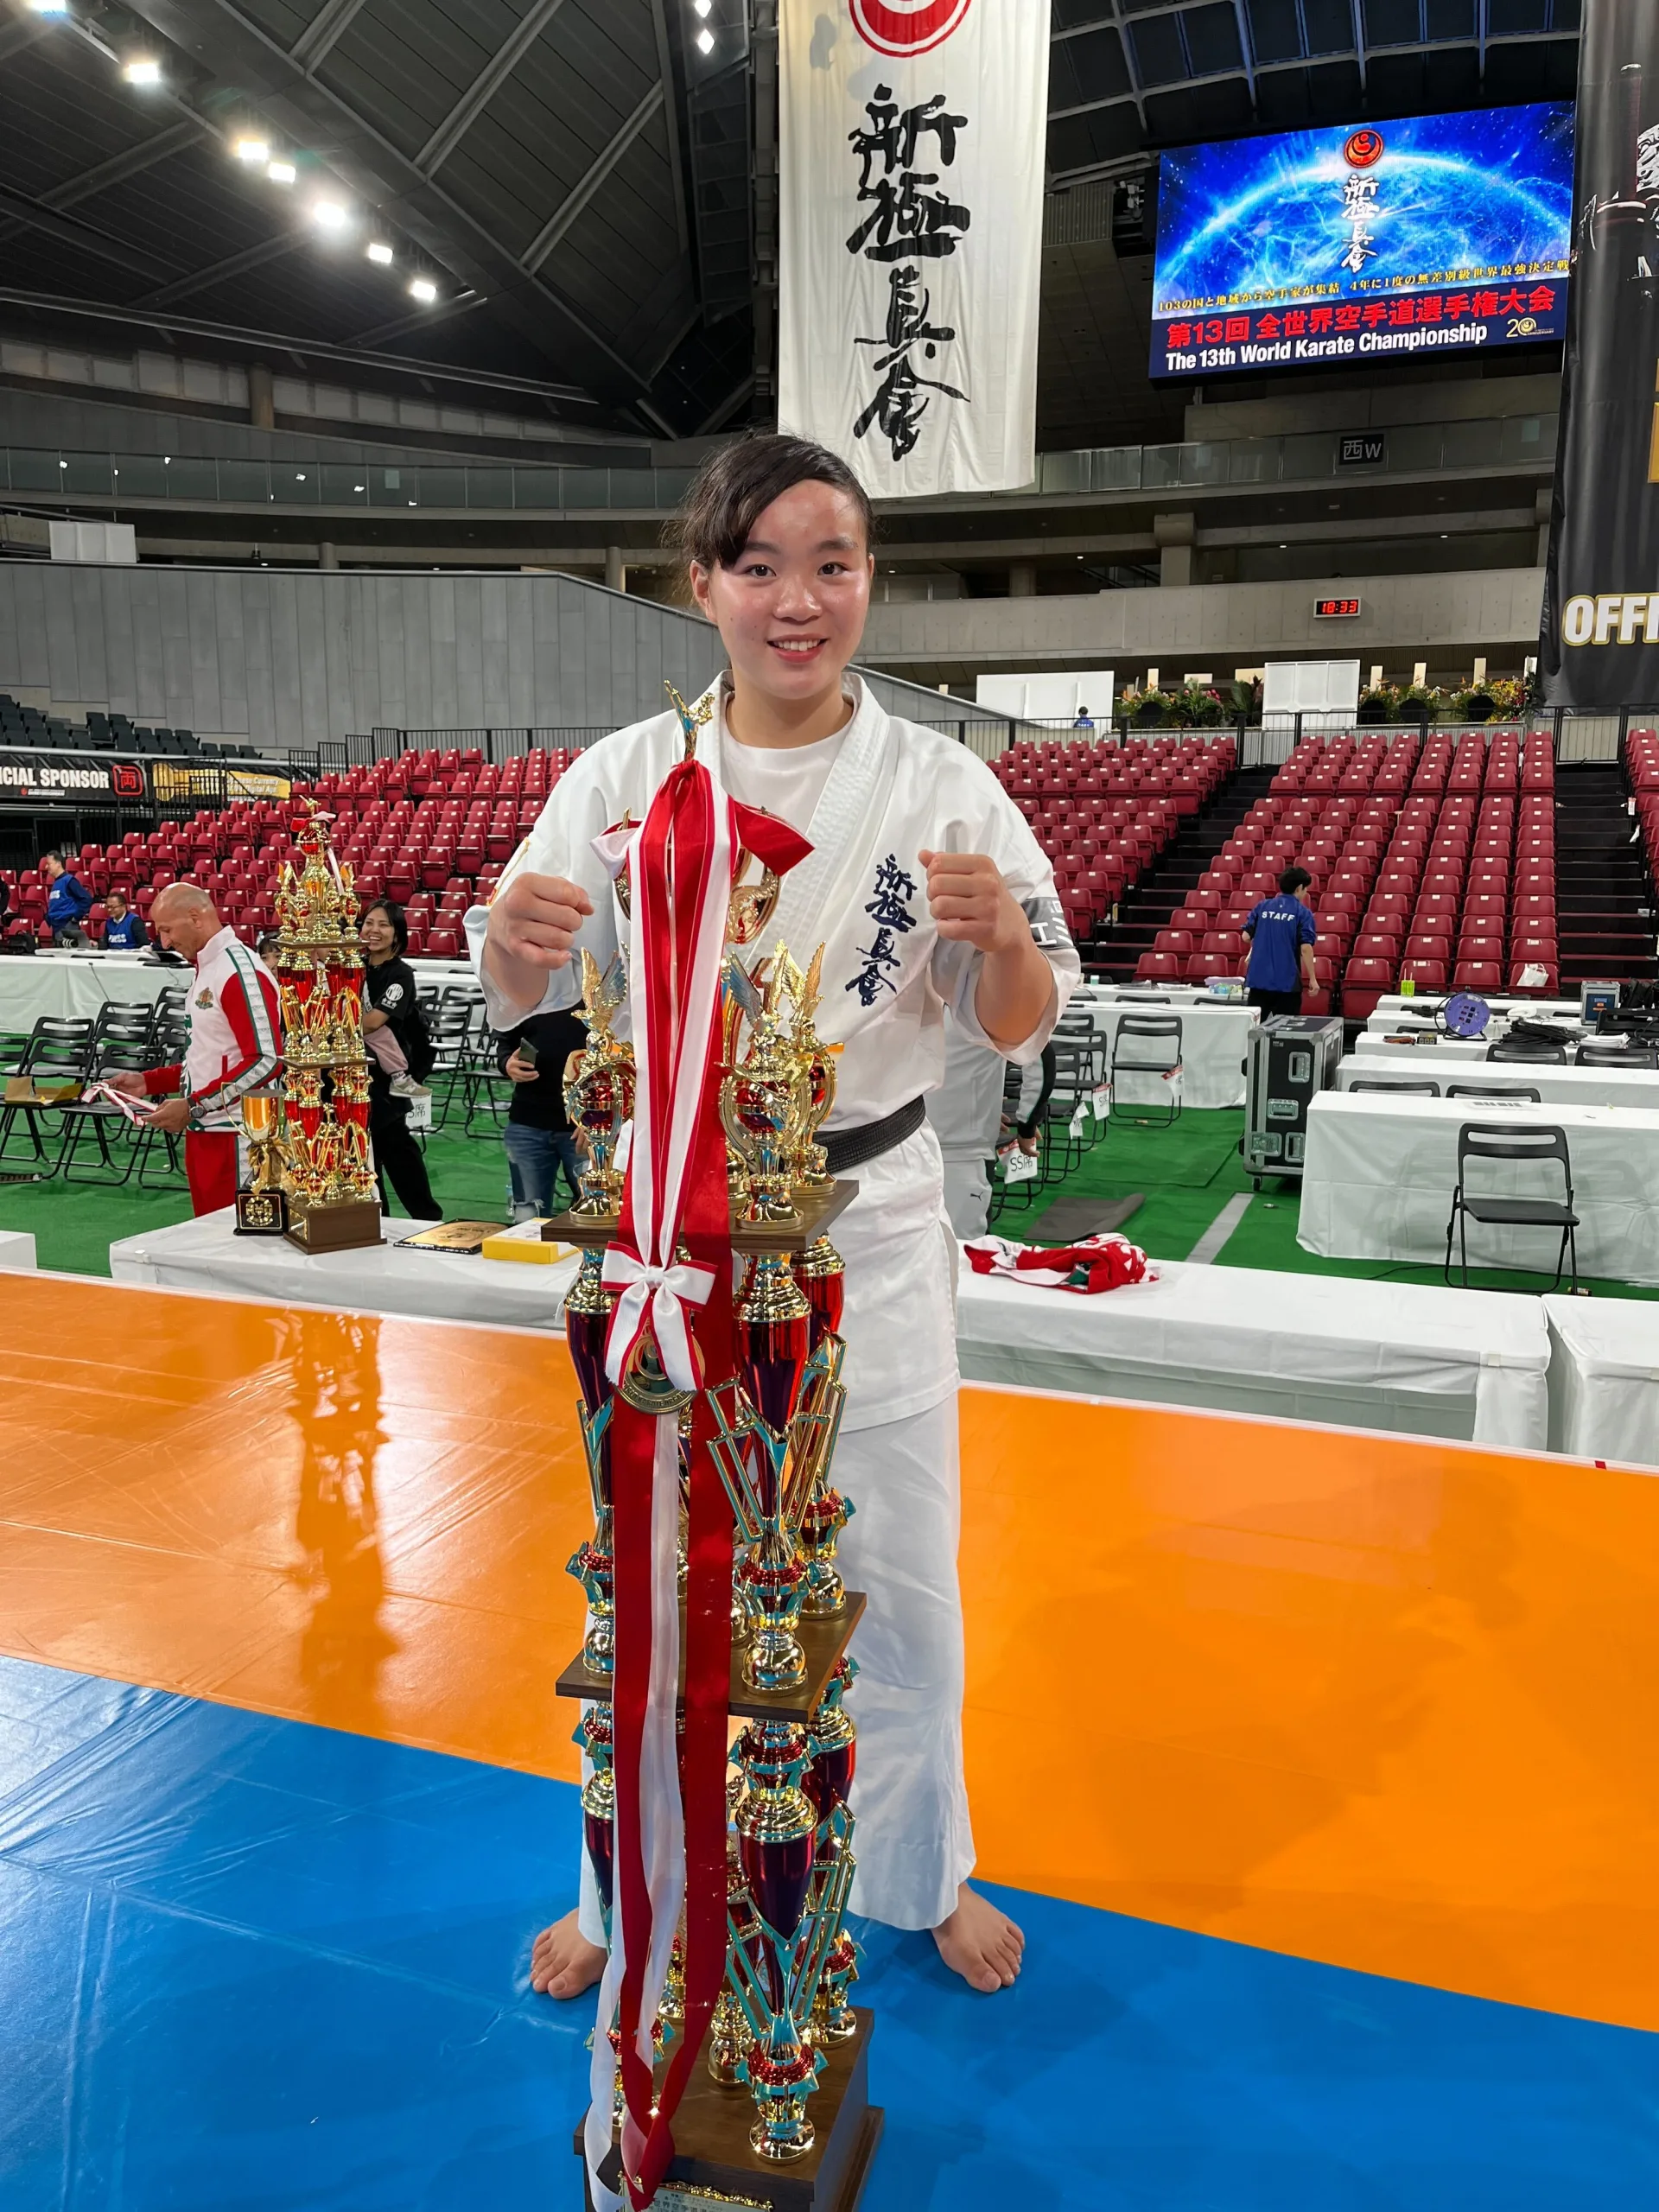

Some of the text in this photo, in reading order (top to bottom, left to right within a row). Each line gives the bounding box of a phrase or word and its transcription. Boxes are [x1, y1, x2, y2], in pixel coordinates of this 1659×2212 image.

[1167, 285, 1556, 349] 第13回 全世界空手道選手権大会
[1166, 322, 1488, 371] The 13th World Karate Championship
[1322, 601, 1357, 613] 18:33
[40, 768, 110, 789] SPONSOR
[1262, 911, 1295, 922] STAFF
